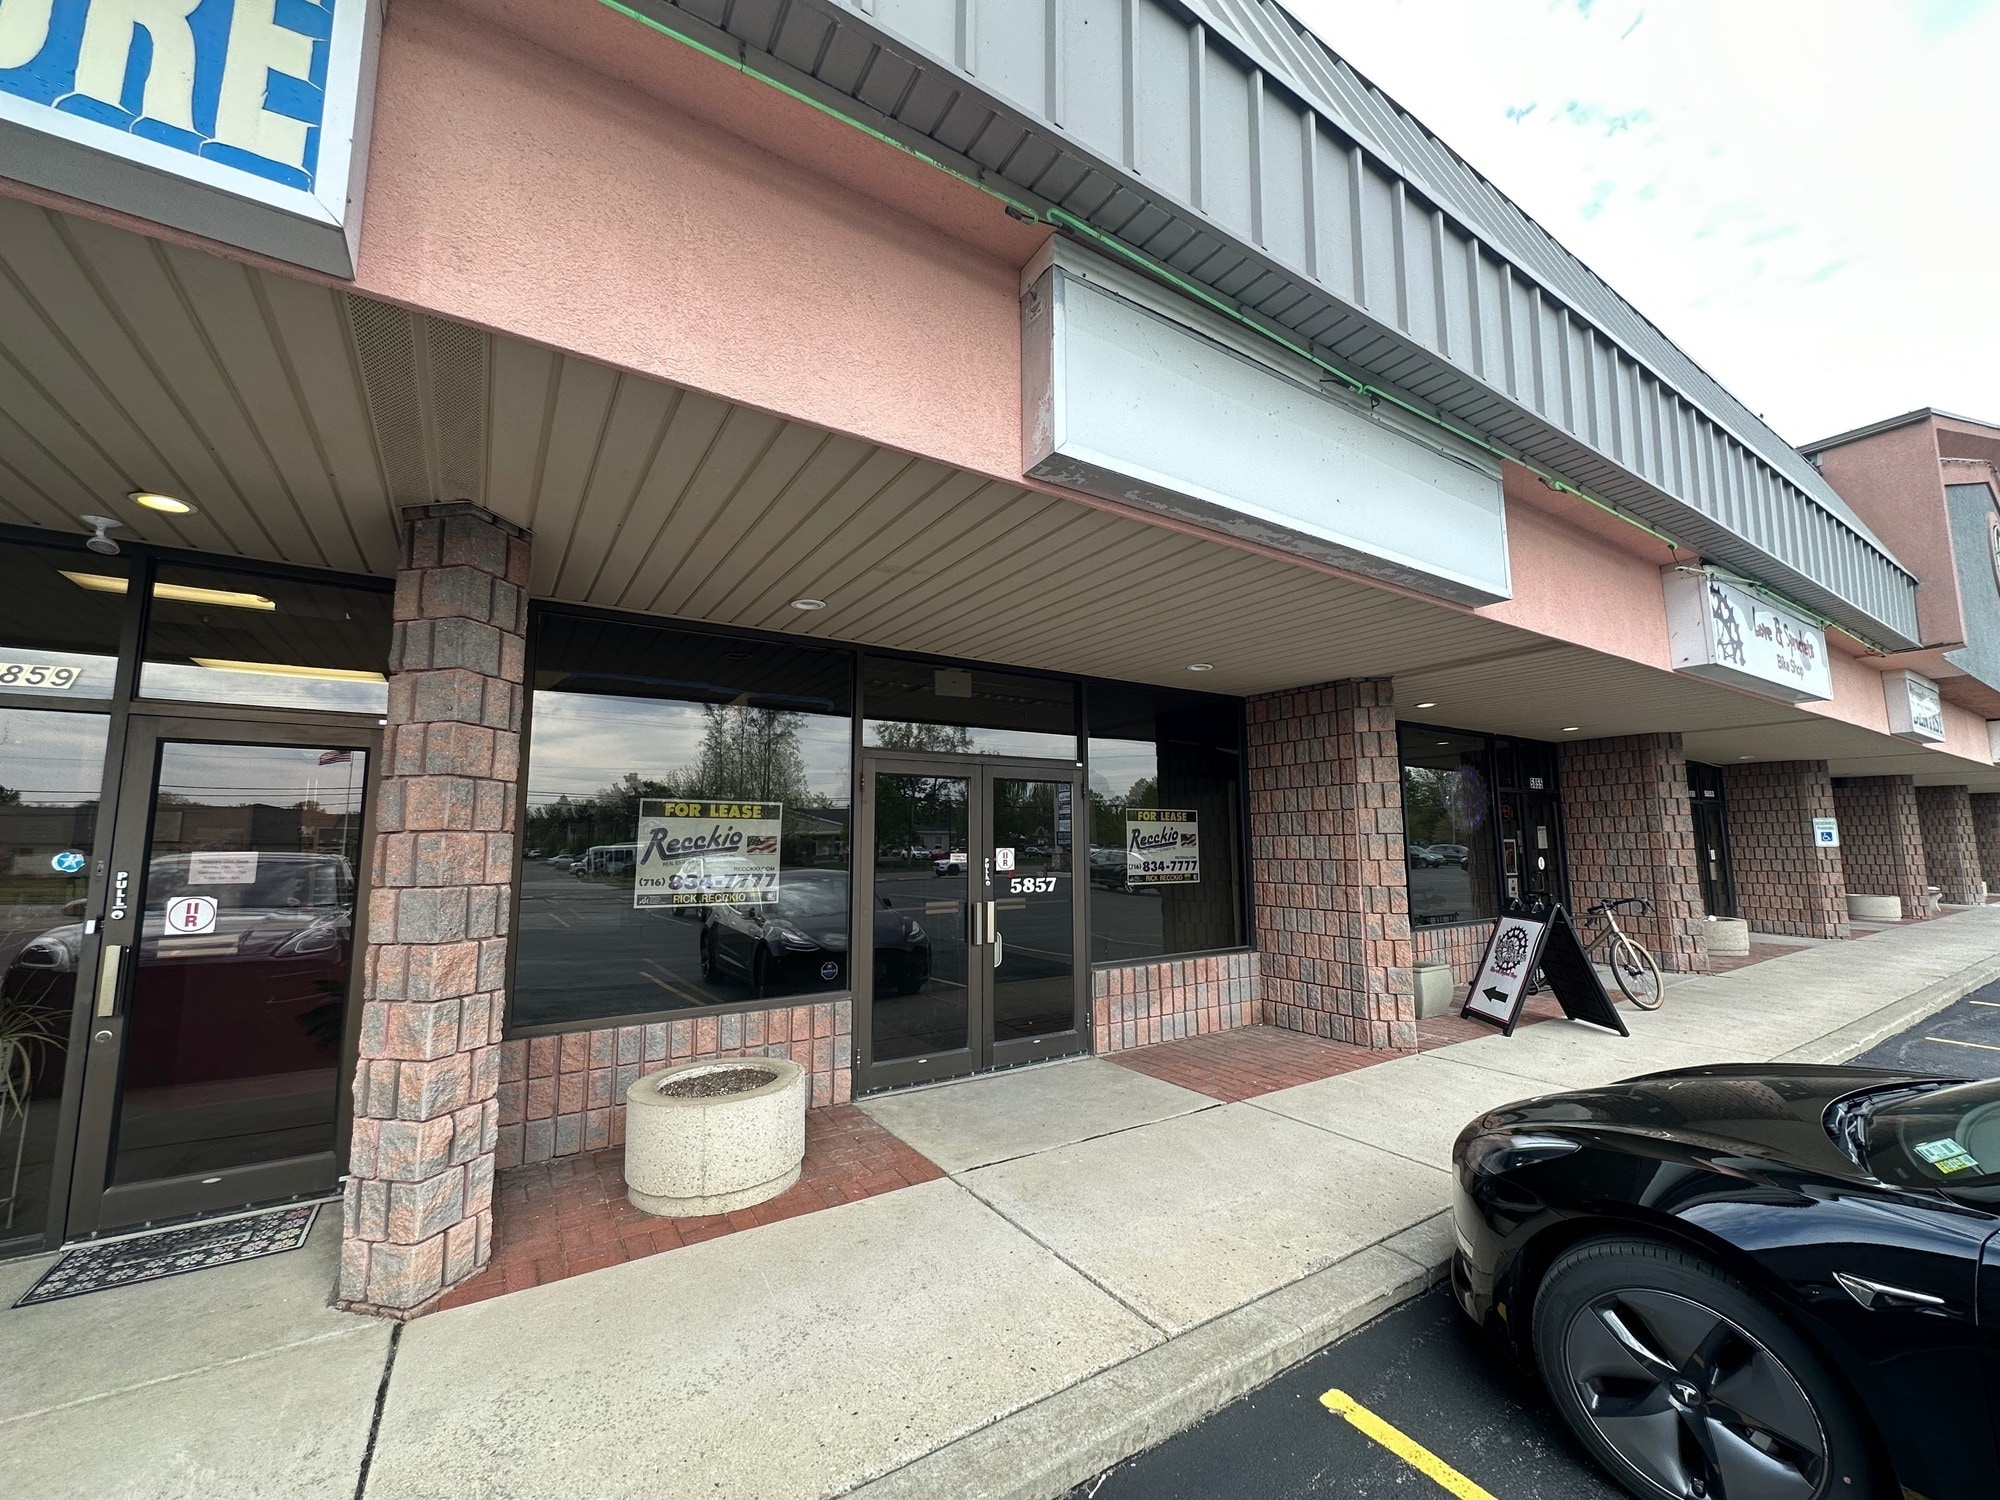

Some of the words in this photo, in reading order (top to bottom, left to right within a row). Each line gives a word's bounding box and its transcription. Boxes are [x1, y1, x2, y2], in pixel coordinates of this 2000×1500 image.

[1752, 606, 1773, 641] Love
[1773, 617, 1784, 648] &
[1776, 654, 1790, 672] Bike
[1790, 659, 1804, 680] Shop
[664, 802, 701, 817] FOR
[710, 803, 762, 818] LEASE
[1138, 811, 1156, 820] FOR
[1160, 812, 1187, 821] LEASE
[640, 824, 743, 866] Recckio
[1128, 826, 1179, 853] Recckio
[1142, 860, 1198, 872] 834-7777
[115, 871, 129, 906] PULL
[639, 877, 666, 887] (716)
[668, 873, 777, 890] 834-7777
[1010, 877, 1057, 894] 5857
[672, 893, 697, 904] RICK
[701, 892, 746, 903] RECCKIO
